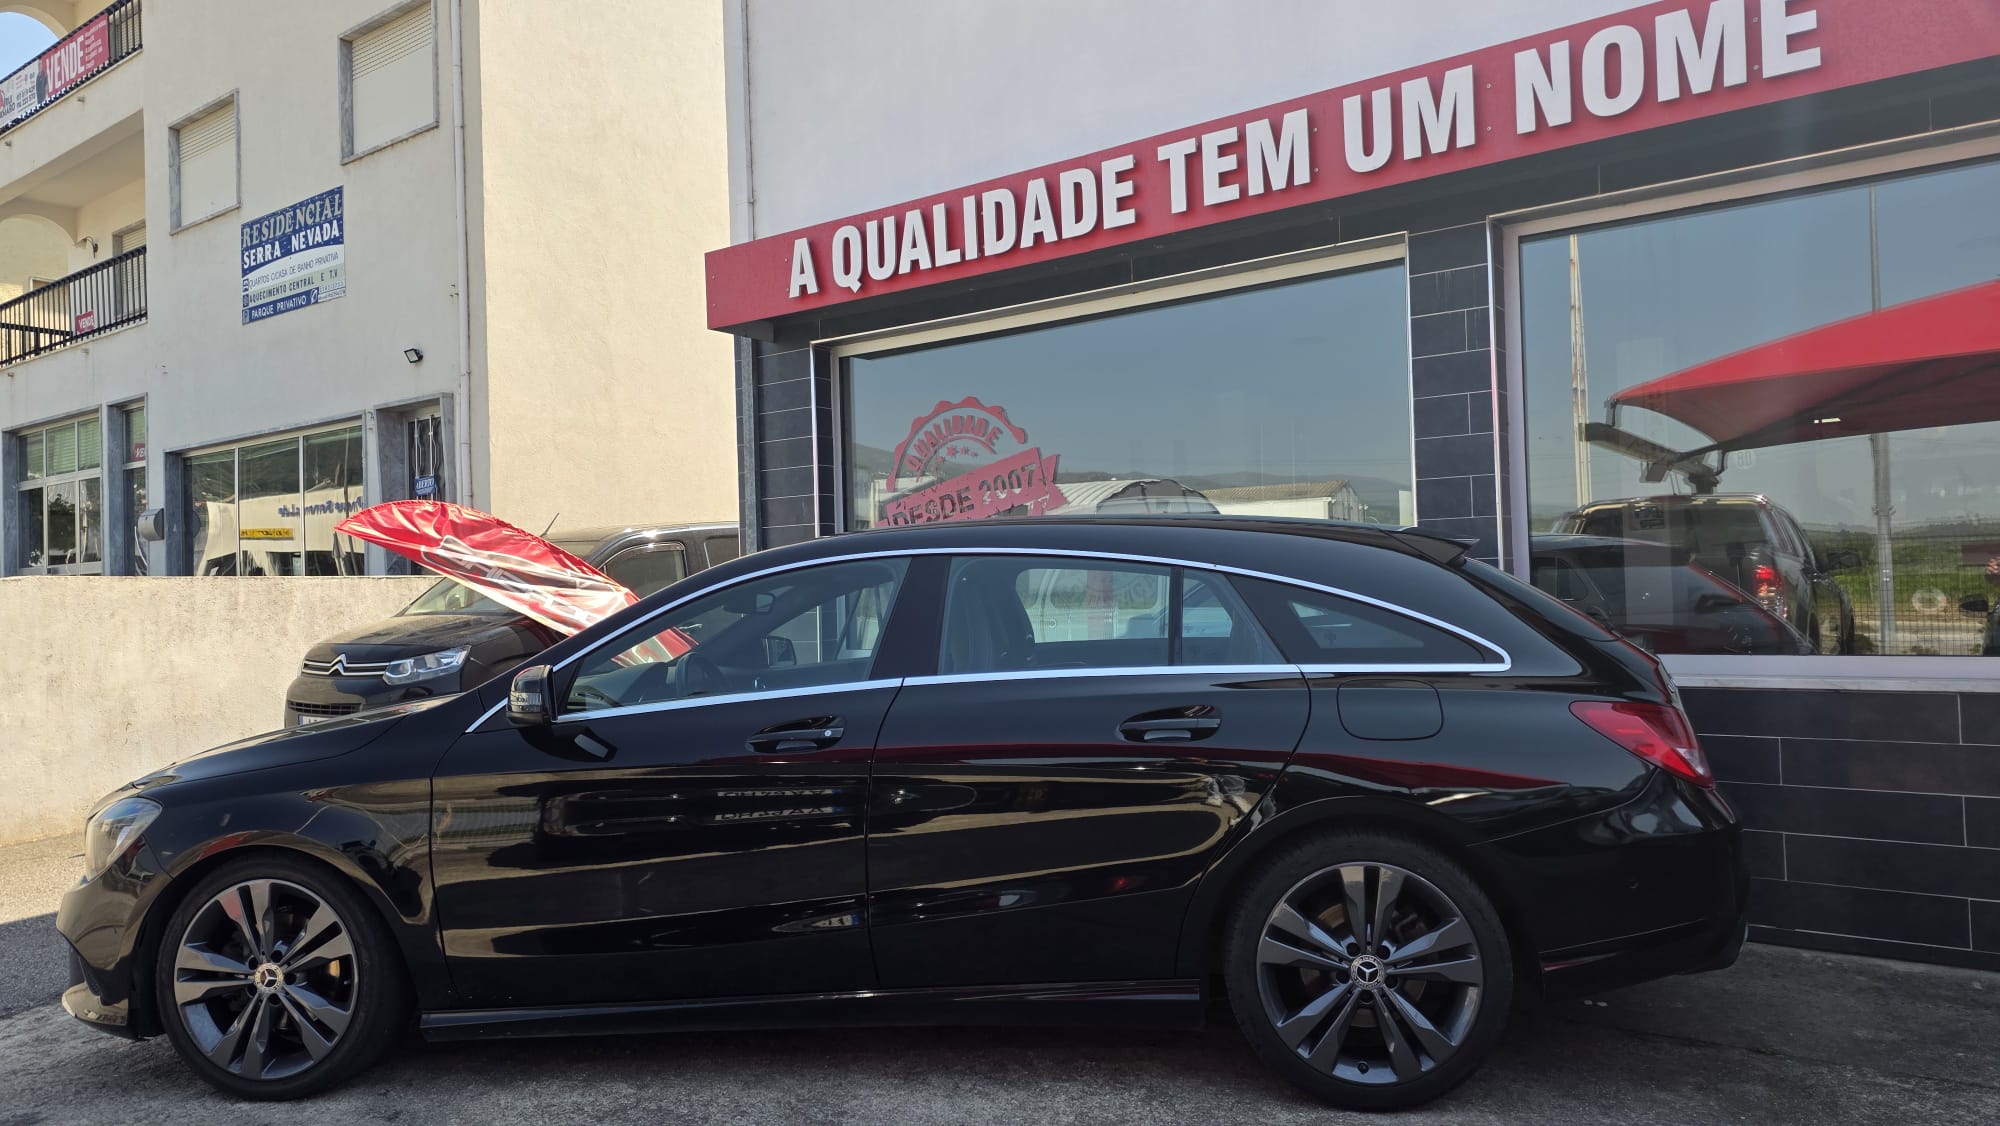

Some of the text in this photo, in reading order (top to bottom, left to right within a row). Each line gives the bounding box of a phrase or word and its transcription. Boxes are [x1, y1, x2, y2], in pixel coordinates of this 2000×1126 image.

[46, 35, 85, 93] VENDE
[788, 0, 1822, 299] A QUALIDADE TEM UM NOME
[242, 193, 343, 249] RESIDENCIAL
[243, 220, 340, 269] SERRA NEVADA
[249, 283, 287, 304] AQUECIMENTO
[288, 275, 315, 294] CENTRAL
[320, 272, 325, 282] E
[251, 306, 274, 320] PARQUE
[276, 295, 307, 312] PRIVATIVO
[905, 414, 1005, 472] QUALIDADE
[978, 462, 1037, 505] 2007
